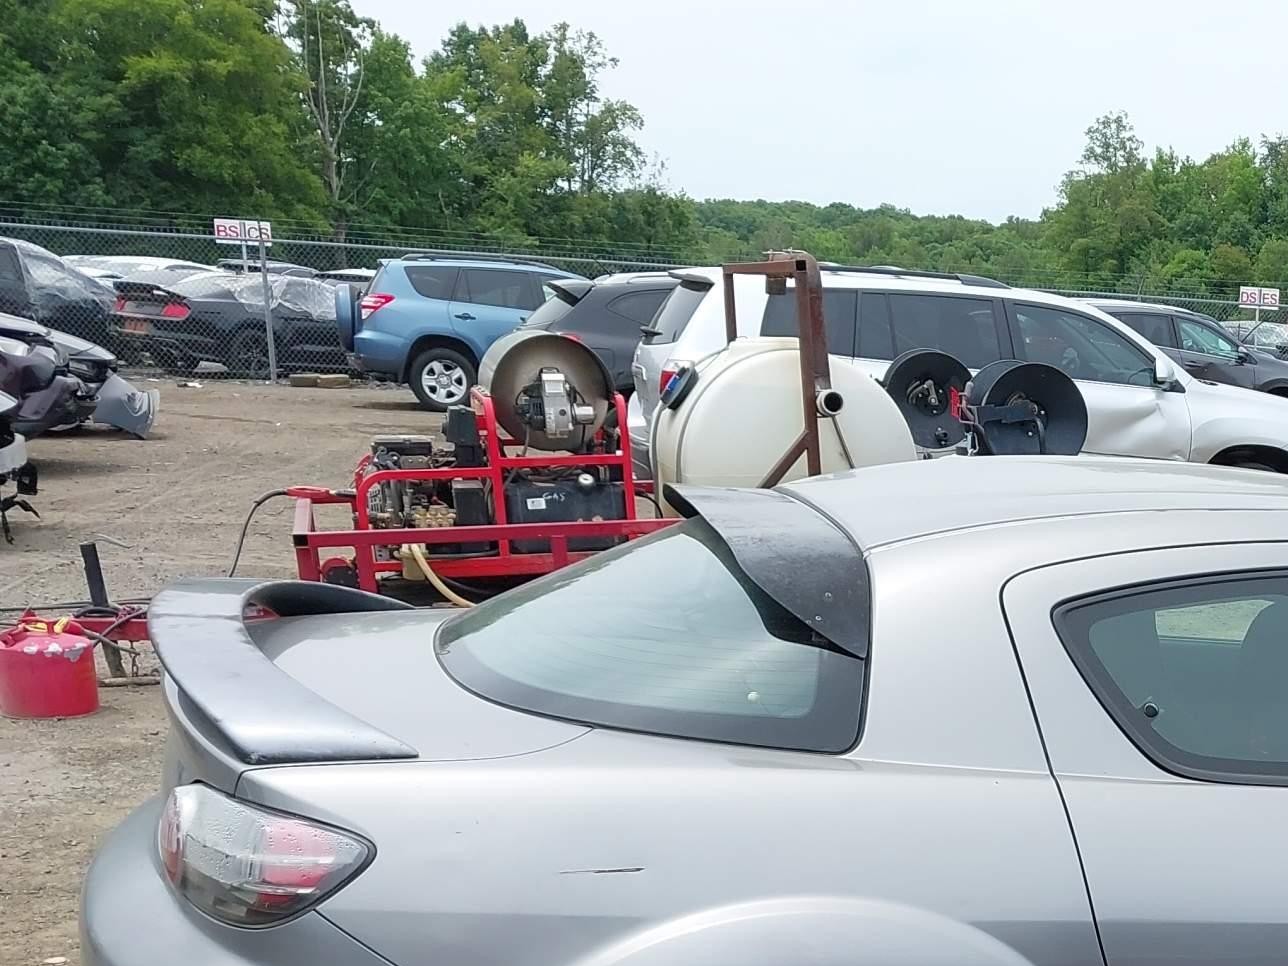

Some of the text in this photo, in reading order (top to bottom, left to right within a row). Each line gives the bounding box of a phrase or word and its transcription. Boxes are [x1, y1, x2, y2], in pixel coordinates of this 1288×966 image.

[216, 225, 270, 241] BS CS
[1241, 291, 1278, 305] DS ES
[542, 492, 566, 502] GAS
